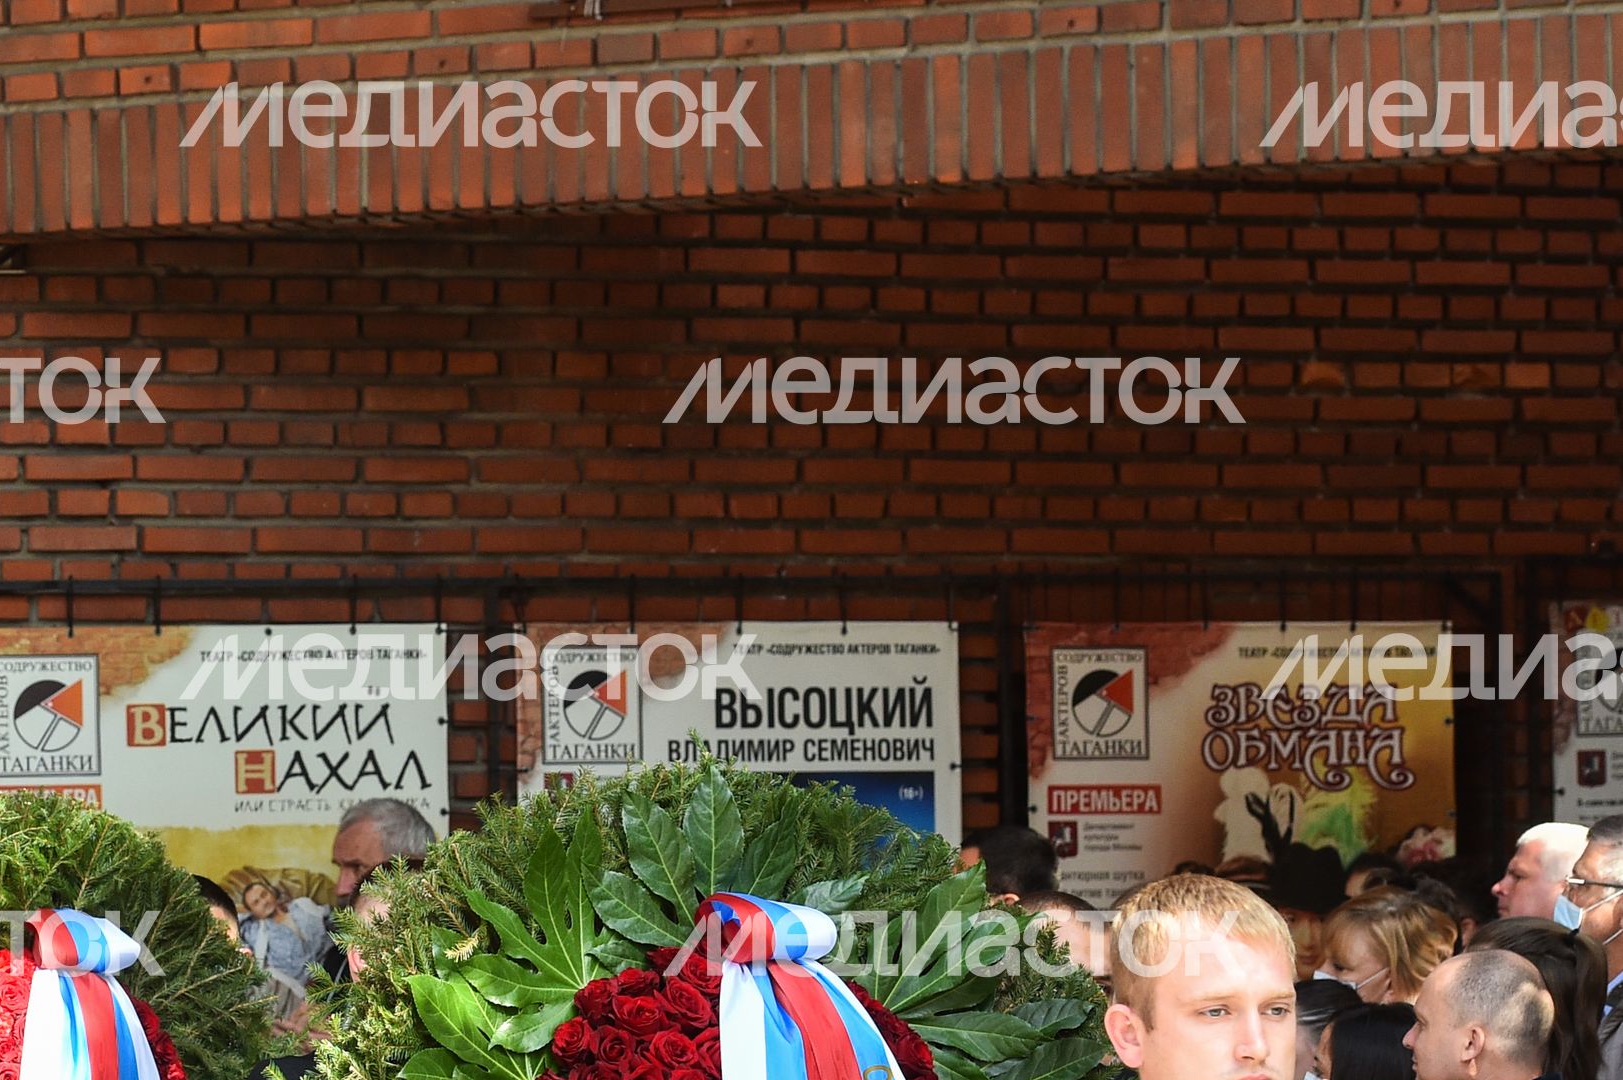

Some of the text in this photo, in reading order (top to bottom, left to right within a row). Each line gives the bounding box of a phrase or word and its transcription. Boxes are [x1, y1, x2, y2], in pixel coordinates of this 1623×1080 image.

[547, 652, 636, 664] СОДРУЖЕСТВО
[847, 643, 892, 655] АКТЕРОВ
[547, 665, 560, 743] АКТЕРОВ
[715, 675, 934, 736] ВЫСОЦКИЙ
[1057, 665, 1069, 744] АКТЕРОВ
[1204, 681, 1398, 730] ЗВЕЗДА
[549, 743, 636, 760] ТАГАНКИ
[668, 738, 935, 763] ВЛАДИМИР СЕМЕНОВИЧ
[1059, 739, 1142, 756] ТАГАНКИ
[1202, 726, 1415, 792] ОБМАНА
[235, 749, 432, 795] НАХАЛ
[1051, 789, 1159, 813] ПРЕМЬЕРА
